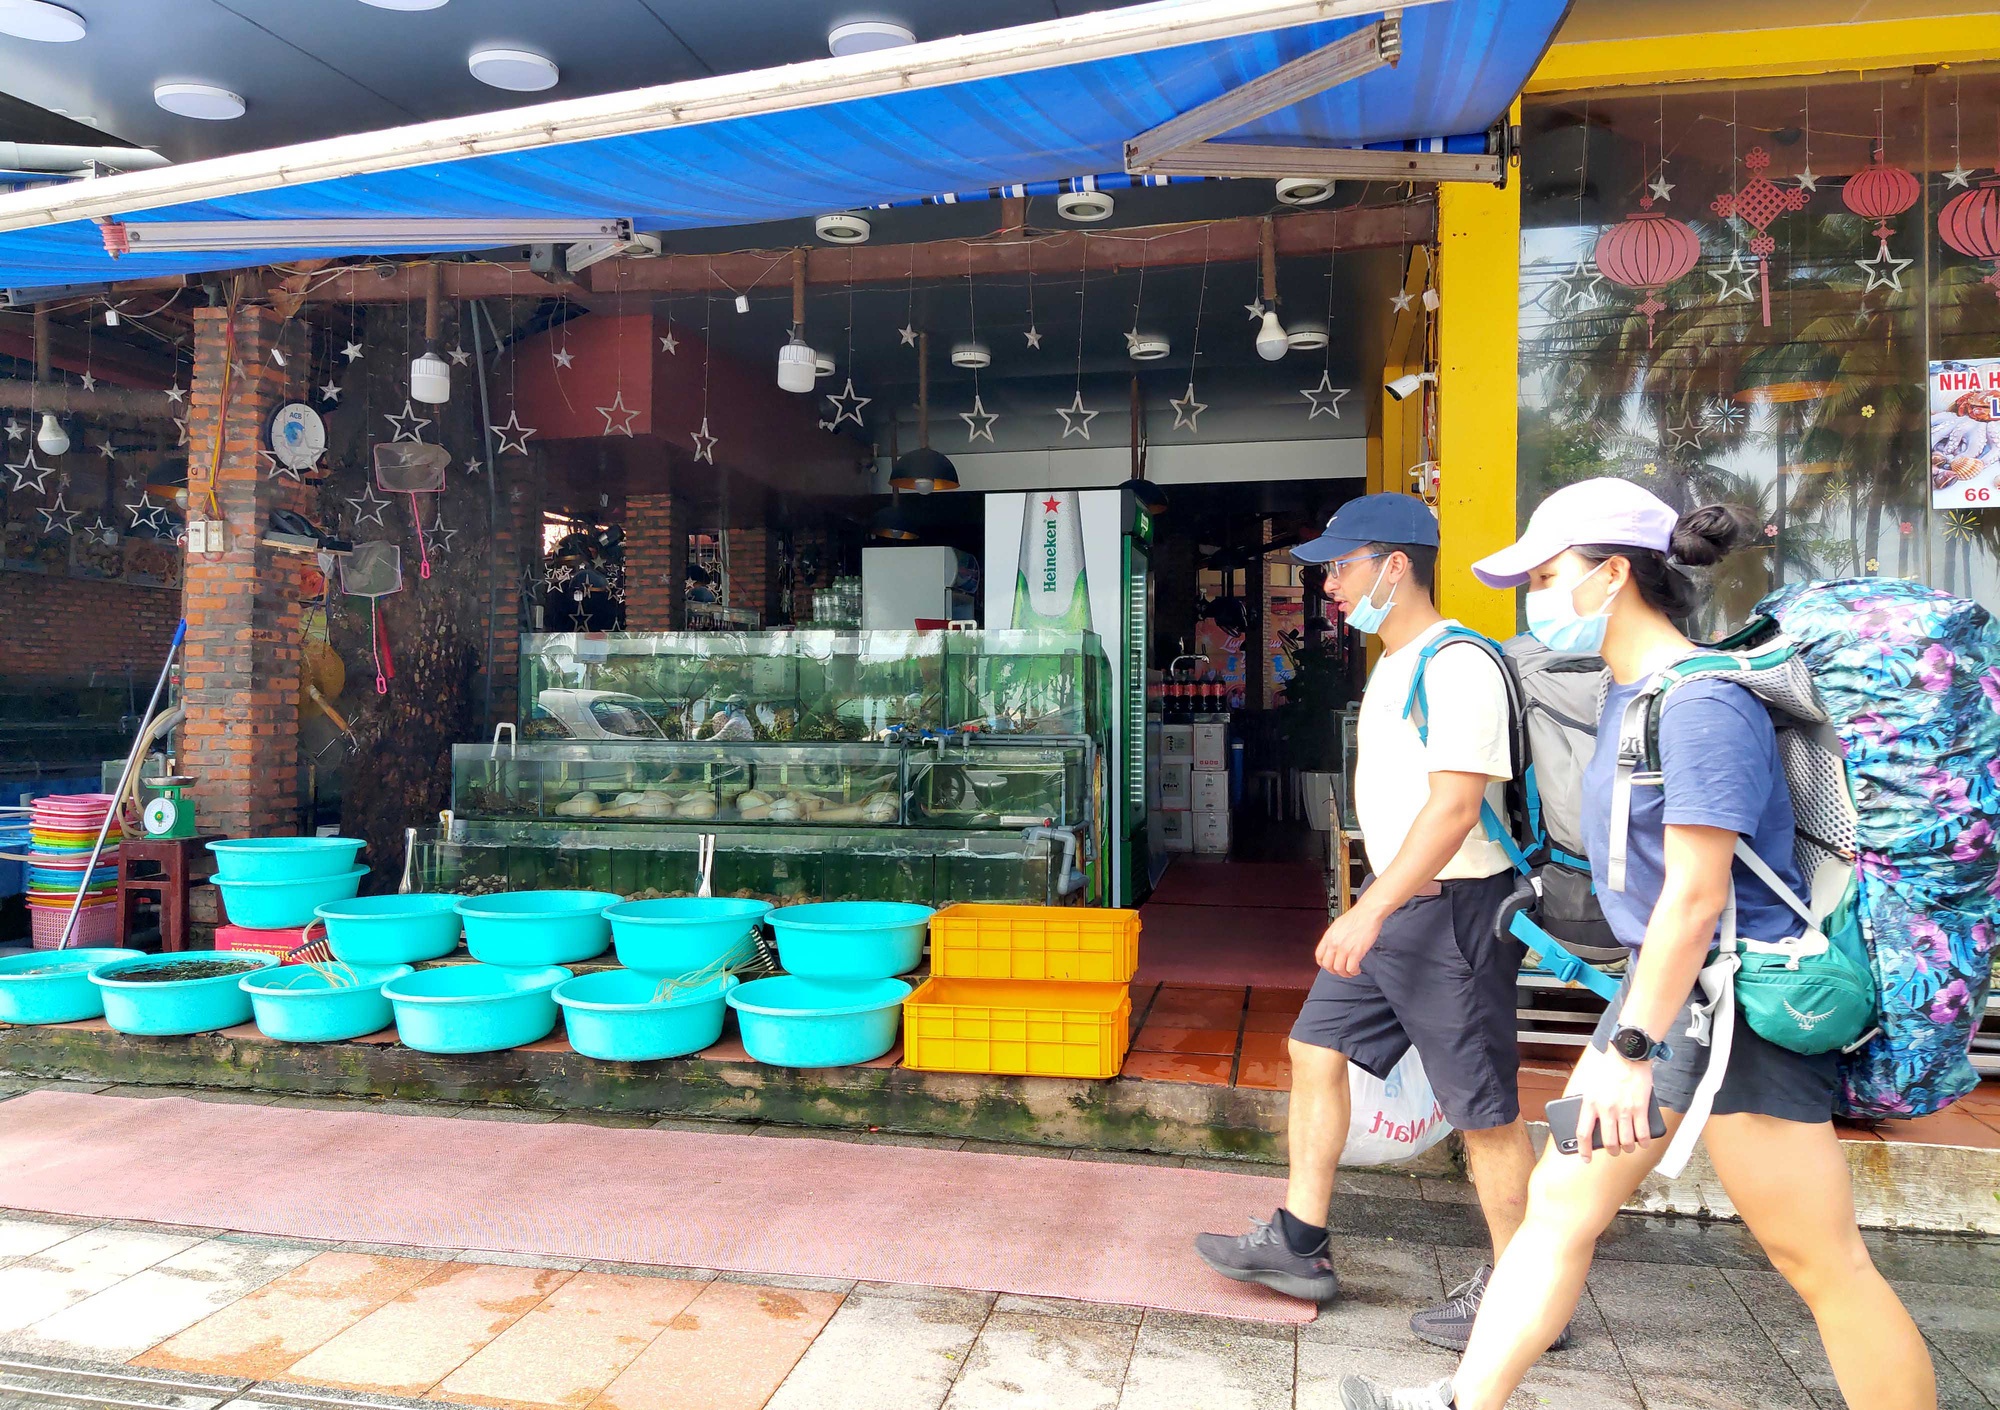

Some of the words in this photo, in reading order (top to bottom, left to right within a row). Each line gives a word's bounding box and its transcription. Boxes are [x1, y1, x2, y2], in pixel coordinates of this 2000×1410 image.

[1940, 369, 1981, 391] NHÀ
[289, 412, 302, 420] ACB
[1965, 488, 1990, 502] 66
[1043, 520, 1057, 592] Heineken
